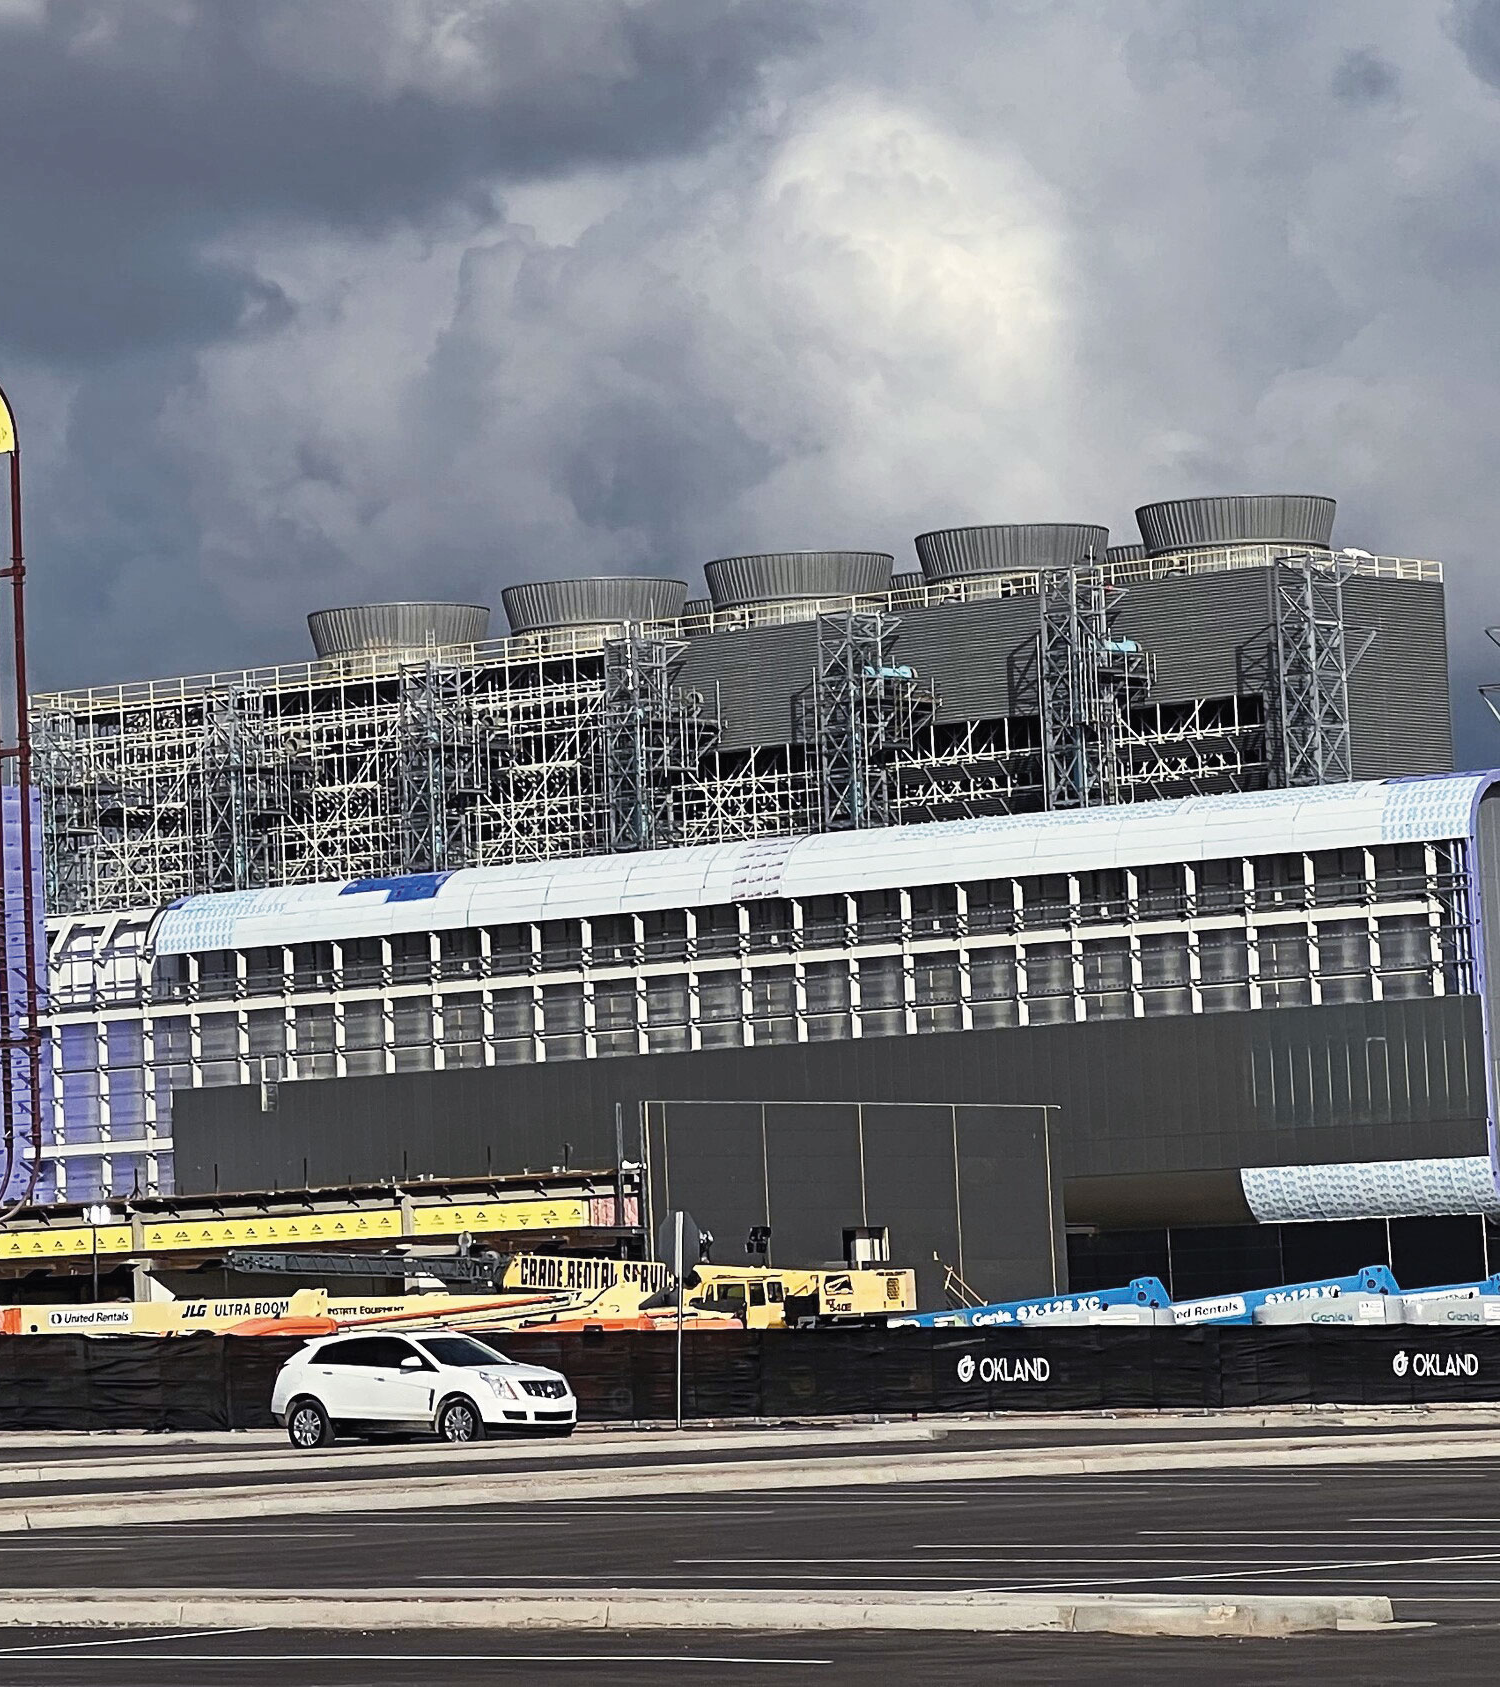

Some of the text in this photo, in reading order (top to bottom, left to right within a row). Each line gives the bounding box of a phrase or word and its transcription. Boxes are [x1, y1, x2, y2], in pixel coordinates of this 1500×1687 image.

[520, 1257, 673, 1293] CRANE RENTAL SERVIC
[181, 1301, 290, 1318] JLG ULTRA BOOM
[1016, 1299, 1074, 1321] SX-125
[1077, 1296, 1101, 1312] XC
[1194, 1302, 1239, 1317] Rentals
[1310, 1311, 1347, 1323] Genie
[1446, 1311, 1480, 1322] Genie
[64, 1311, 129, 1324] United Rentals
[979, 1356, 1050, 1383] OKLAND
[1412, 1352, 1479, 1377] OKLAND
